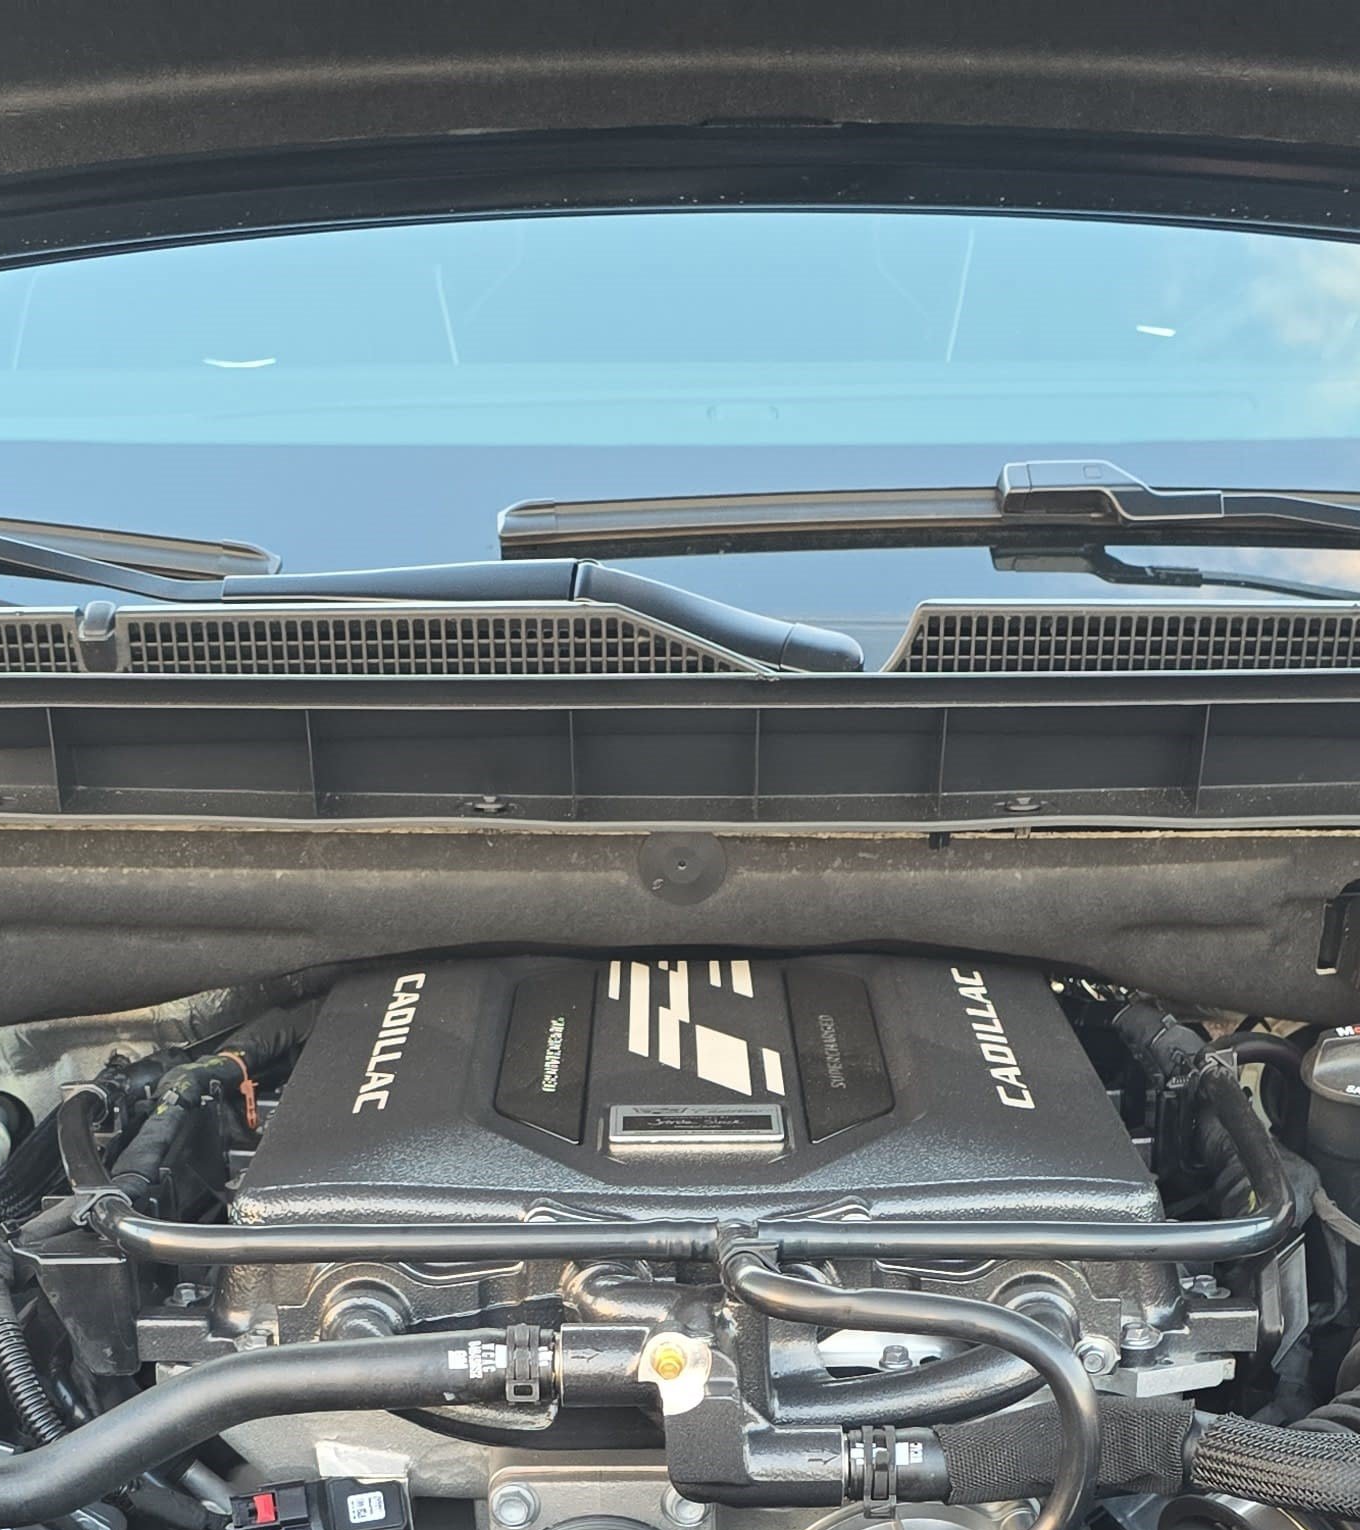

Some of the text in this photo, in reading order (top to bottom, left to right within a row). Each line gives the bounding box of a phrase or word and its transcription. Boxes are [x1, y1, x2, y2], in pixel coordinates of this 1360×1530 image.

[352, 972, 427, 1114] CADILLAC
[817, 1014, 847, 1089] SUPERCHARGED
[950, 967, 1036, 1110] CADILLAC
